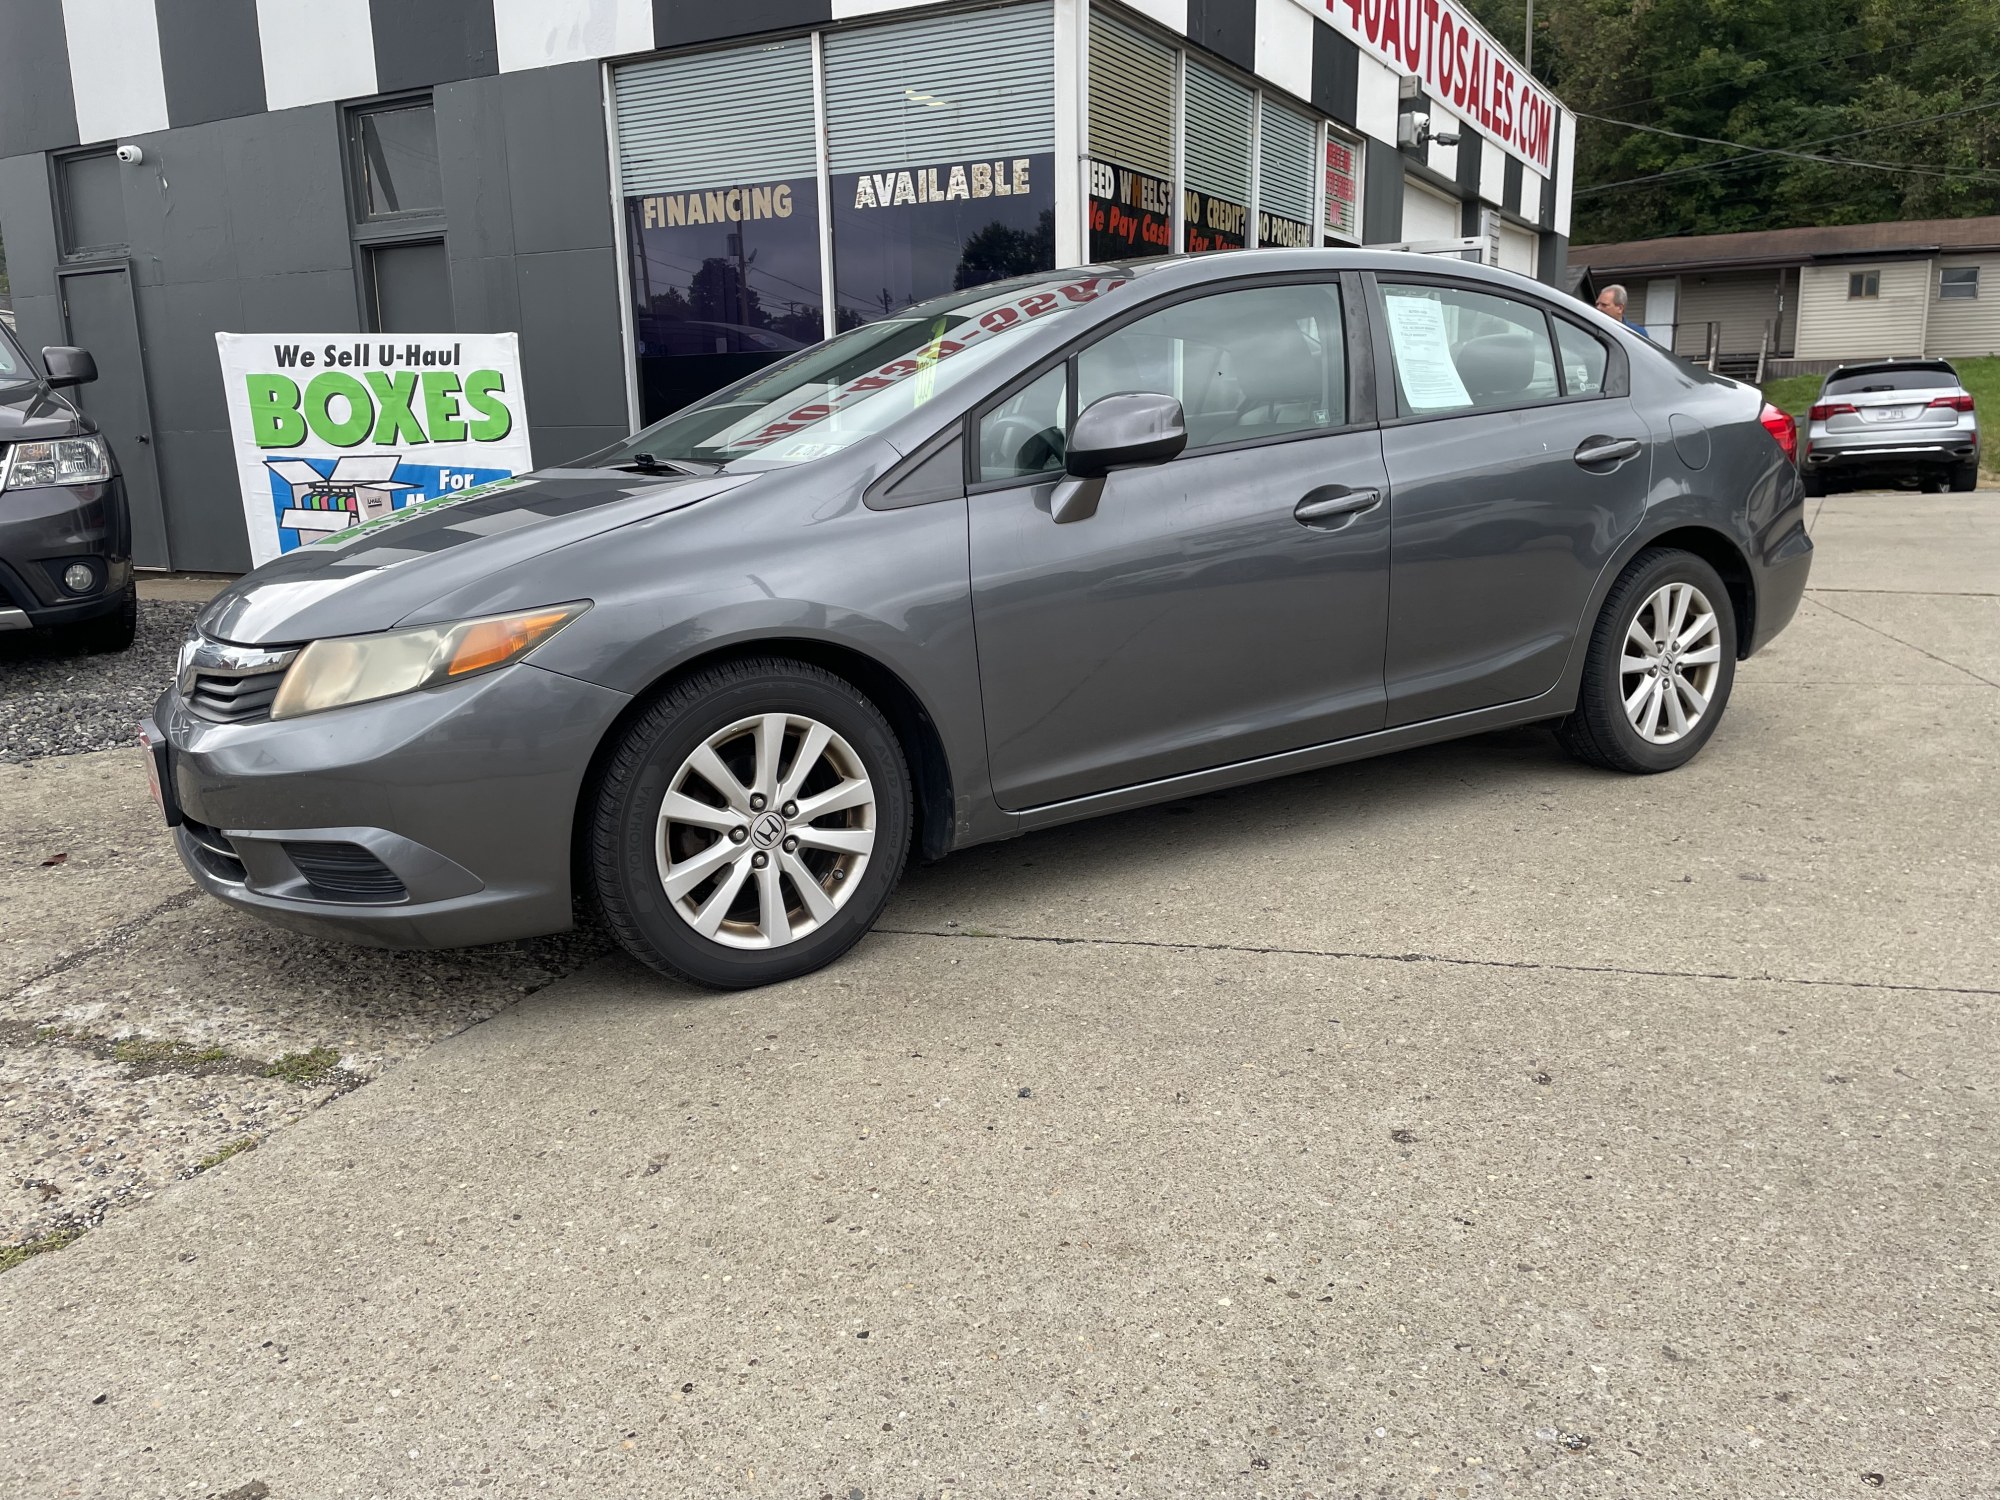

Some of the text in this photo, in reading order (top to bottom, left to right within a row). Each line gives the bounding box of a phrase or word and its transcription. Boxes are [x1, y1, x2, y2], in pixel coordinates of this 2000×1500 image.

[1325, 0, 1551, 168] AUTOSALES.COM
[642, 158, 1031, 229] FINANCING AVAILABLE
[1088, 159, 1115, 200] EED
[1119, 169, 1173, 217] WHEELS?
[1184, 188, 1200, 224] NO
[1207, 197, 1246, 237] CREDIT?
[1271, 216, 1311, 248] PROBLEM!
[1108, 205, 1138, 245] Pay
[1142, 213, 1172, 247] Cash
[274, 342, 461, 368] We Sell U-Haul
[246, 369, 513, 449] BOXES
[439, 469, 475, 490] For
[628, 785, 655, 875] YOKOHAMA
